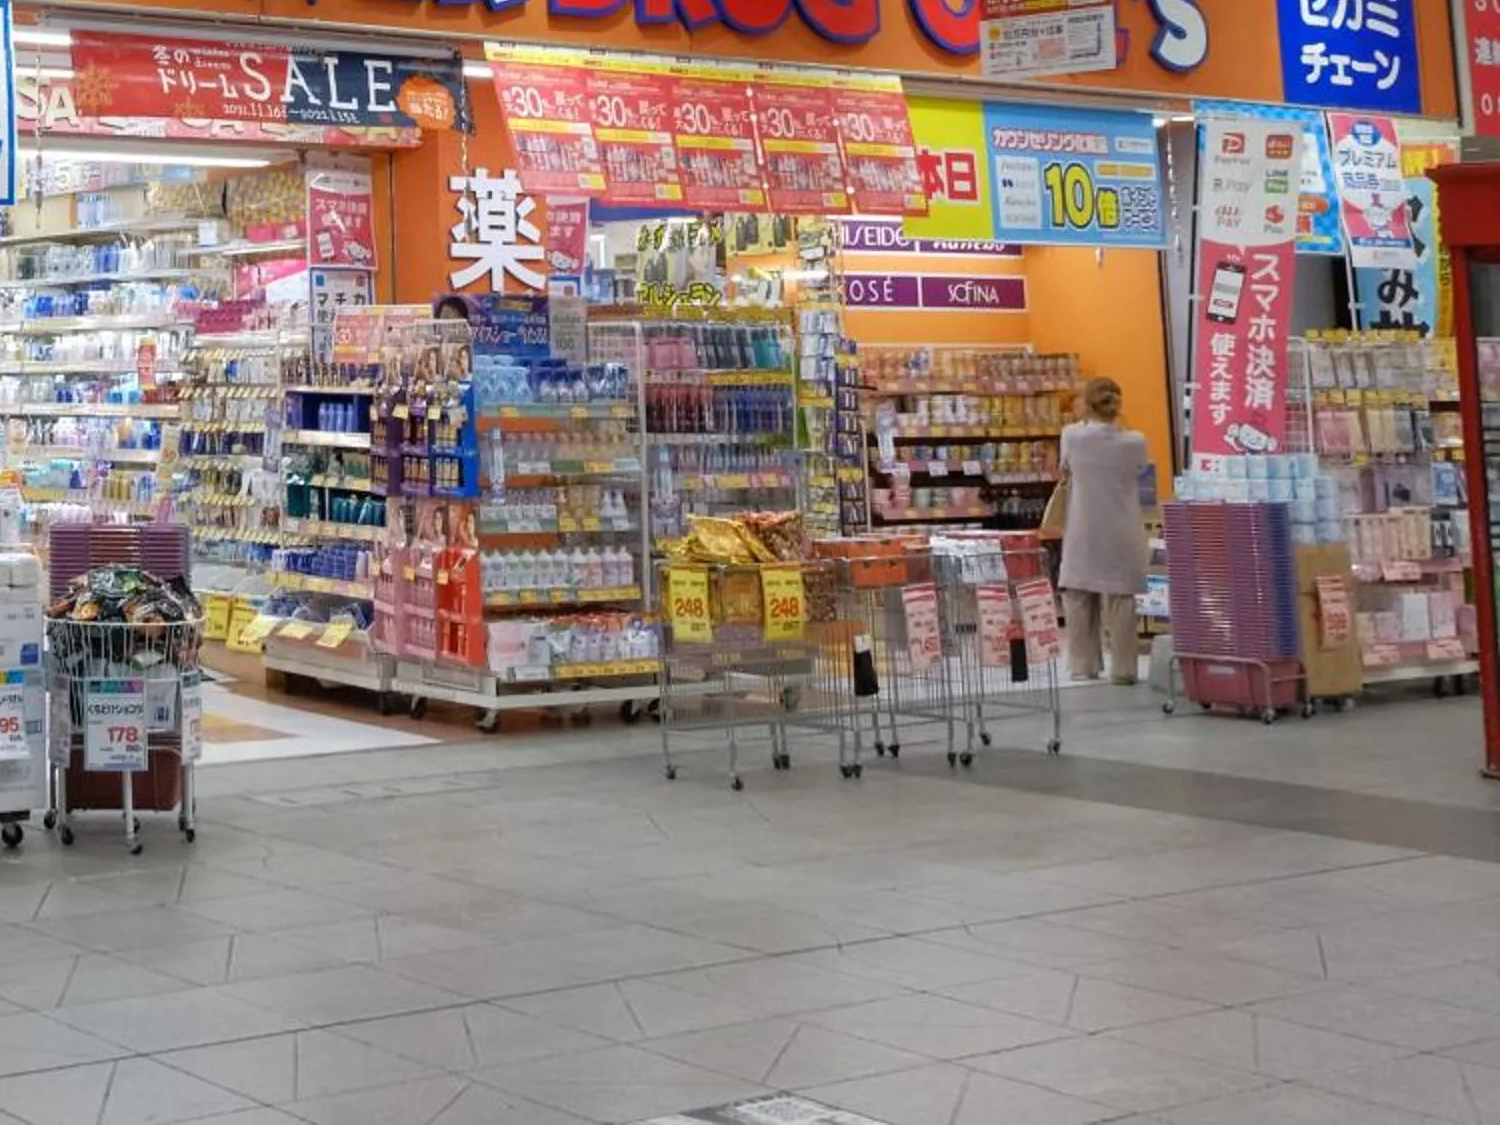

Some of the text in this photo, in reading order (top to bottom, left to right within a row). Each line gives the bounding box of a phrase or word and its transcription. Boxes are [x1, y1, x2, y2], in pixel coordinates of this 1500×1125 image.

[152, 44, 190, 66] 冬の
[1300, 42, 1402, 90] チェーン
[158, 50, 398, 113] ドリーム SALE
[450, 167, 548, 293] 薬
[843, 273, 894, 300] OSÉ
[1244, 253, 1280, 411] スマホ決済
[1208, 332, 1237, 425] 使えます
[675, 596, 705, 618] 248
[770, 596, 800, 619] 248
[107, 725, 140, 743] 178
